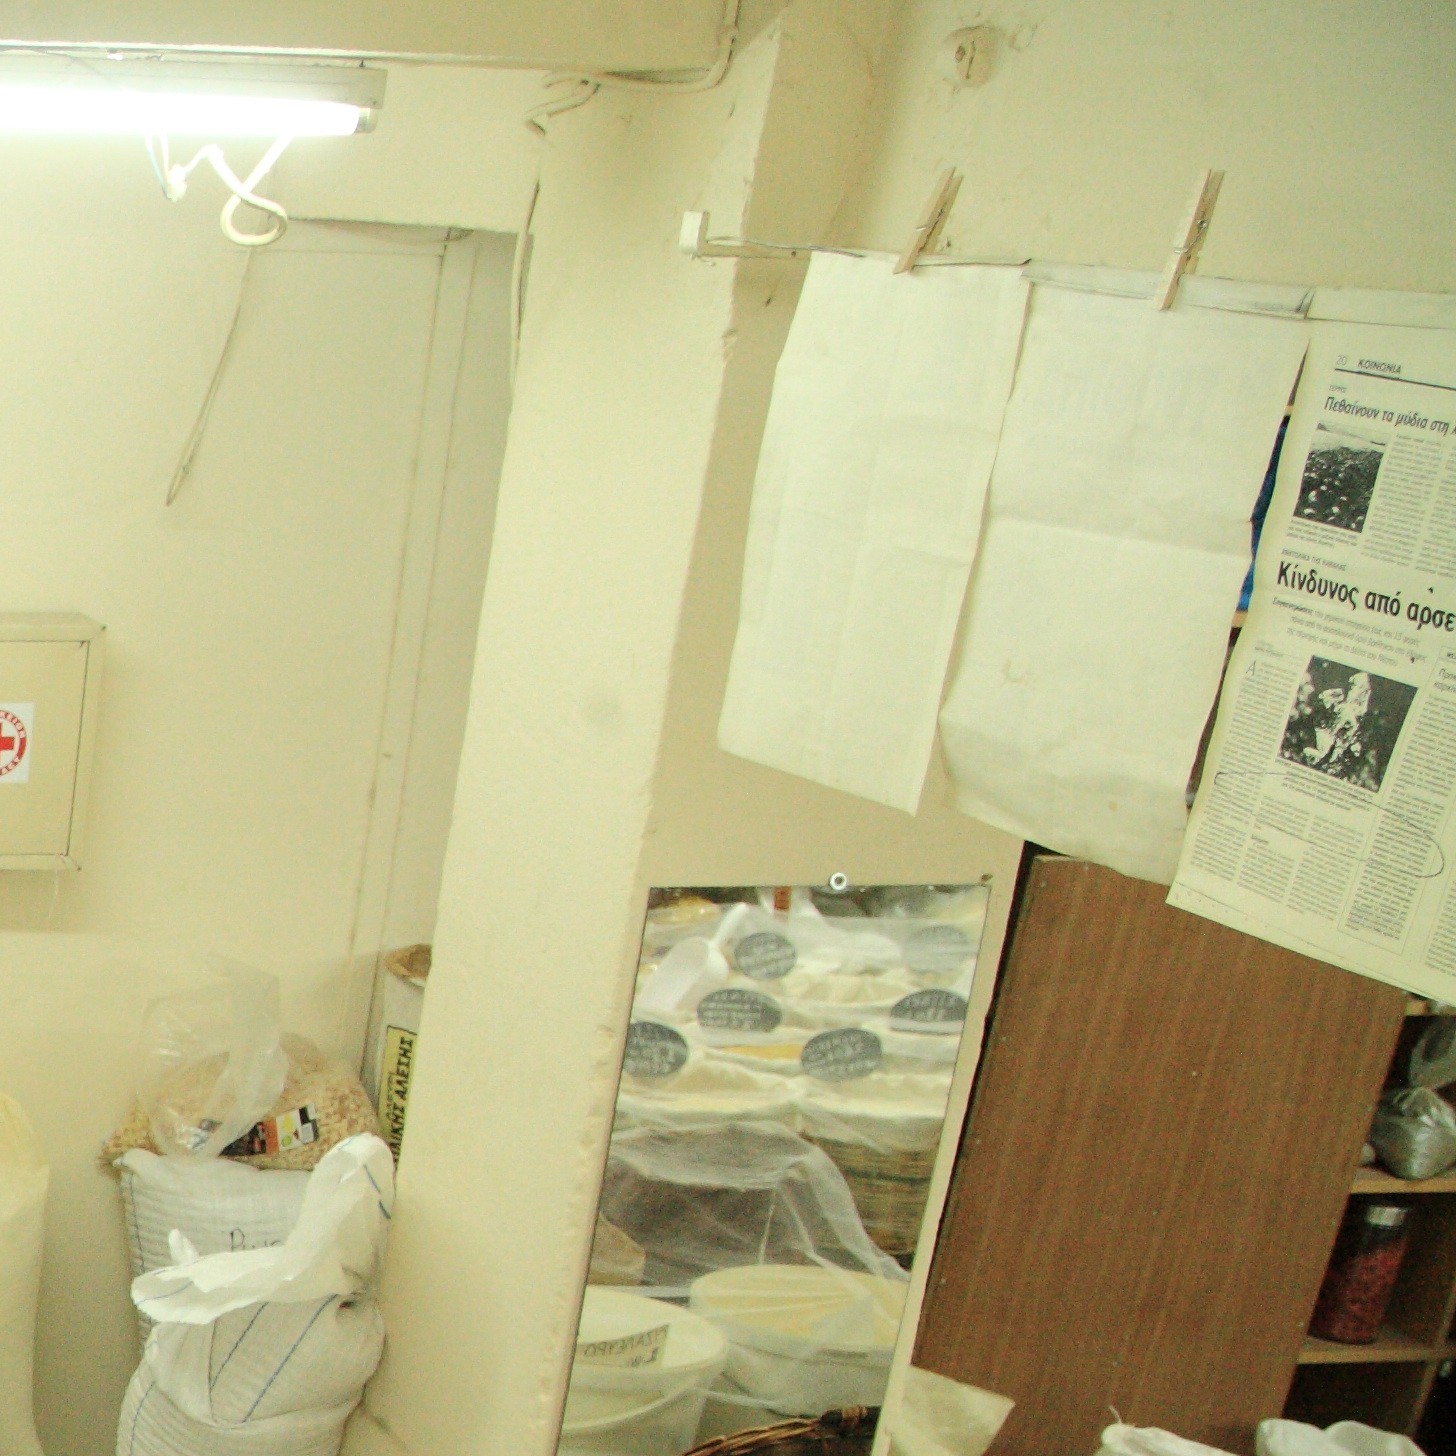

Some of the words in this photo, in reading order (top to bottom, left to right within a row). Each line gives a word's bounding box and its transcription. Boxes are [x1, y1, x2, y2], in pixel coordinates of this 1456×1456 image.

[1323, 396, 1380, 419] Πεθαίνουν
[1382, 409, 1395, 423] τα
[1394, 410, 1429, 428] μύδια
[1429, 419, 1450, 437] στη
[1276, 560, 1360, 611] Κίνδυνος
[1364, 590, 1402, 617] από
